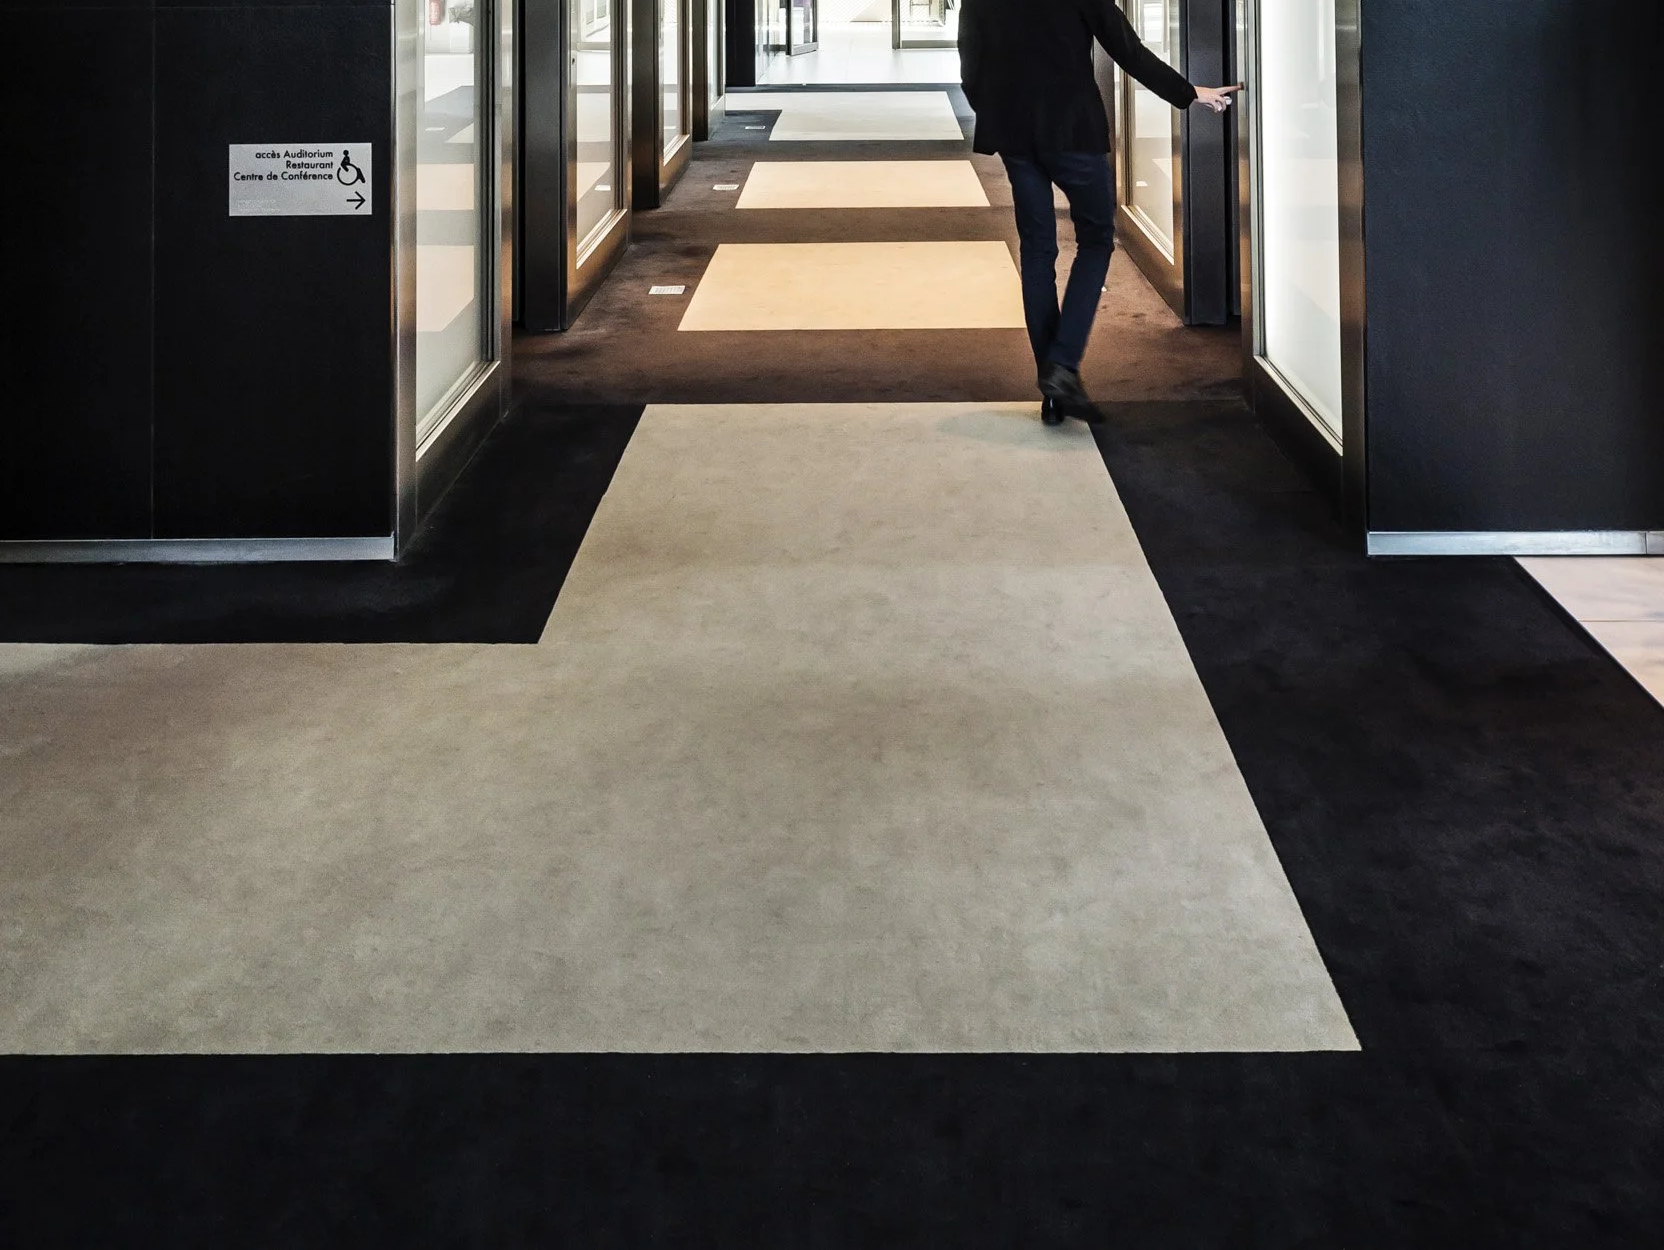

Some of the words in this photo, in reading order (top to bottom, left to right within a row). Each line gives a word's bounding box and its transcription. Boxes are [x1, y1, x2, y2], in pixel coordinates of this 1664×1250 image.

[255, 150, 281, 159] accès
[283, 149, 334, 158] Auditorium
[286, 160, 334, 170] Restaurant
[233, 172, 264, 181] Centre
[266, 171, 278, 180] de
[280, 171, 334, 181] Conférence
